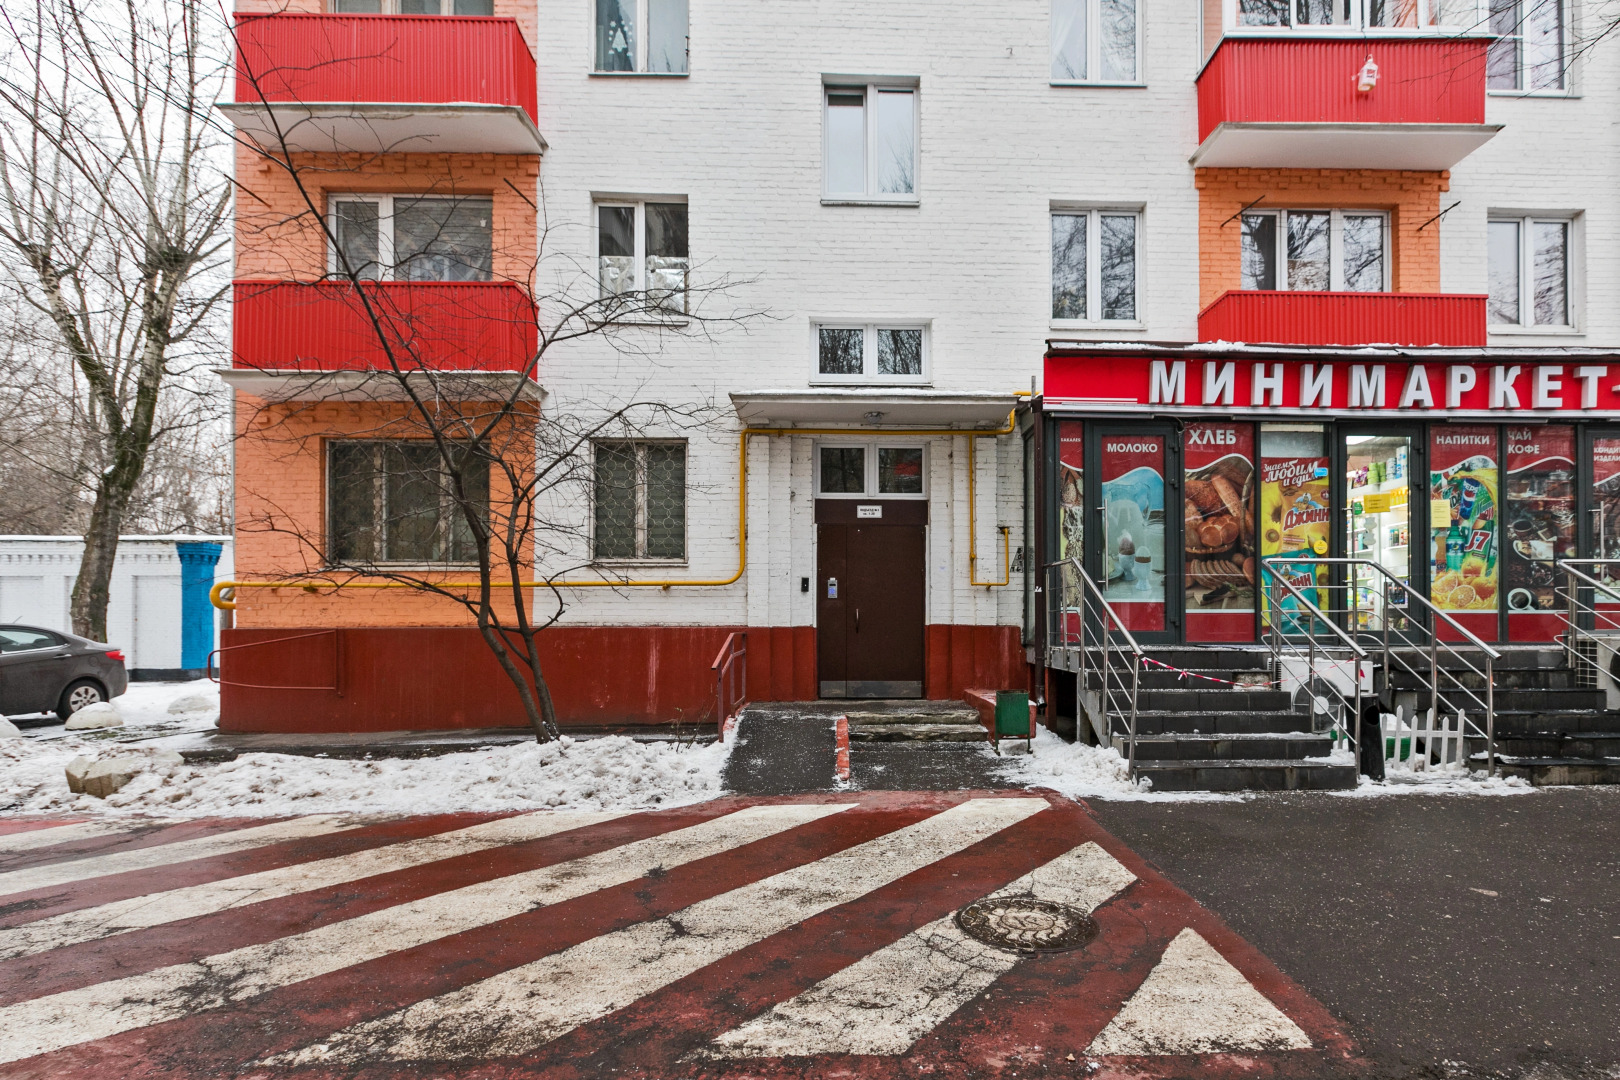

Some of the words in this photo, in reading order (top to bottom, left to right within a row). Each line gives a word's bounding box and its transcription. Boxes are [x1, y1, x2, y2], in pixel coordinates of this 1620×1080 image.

[1149, 360, 1608, 409] МИНИМАРКЕТ
[1188, 429, 1237, 445] ХЛЕБ
[1436, 435, 1490, 445] НАПИТКИ
[1507, 427, 1532, 441] ЧАЙ
[1107, 443, 1158, 453] МОЛОКО
[1508, 444, 1540, 454] КОФЕ
